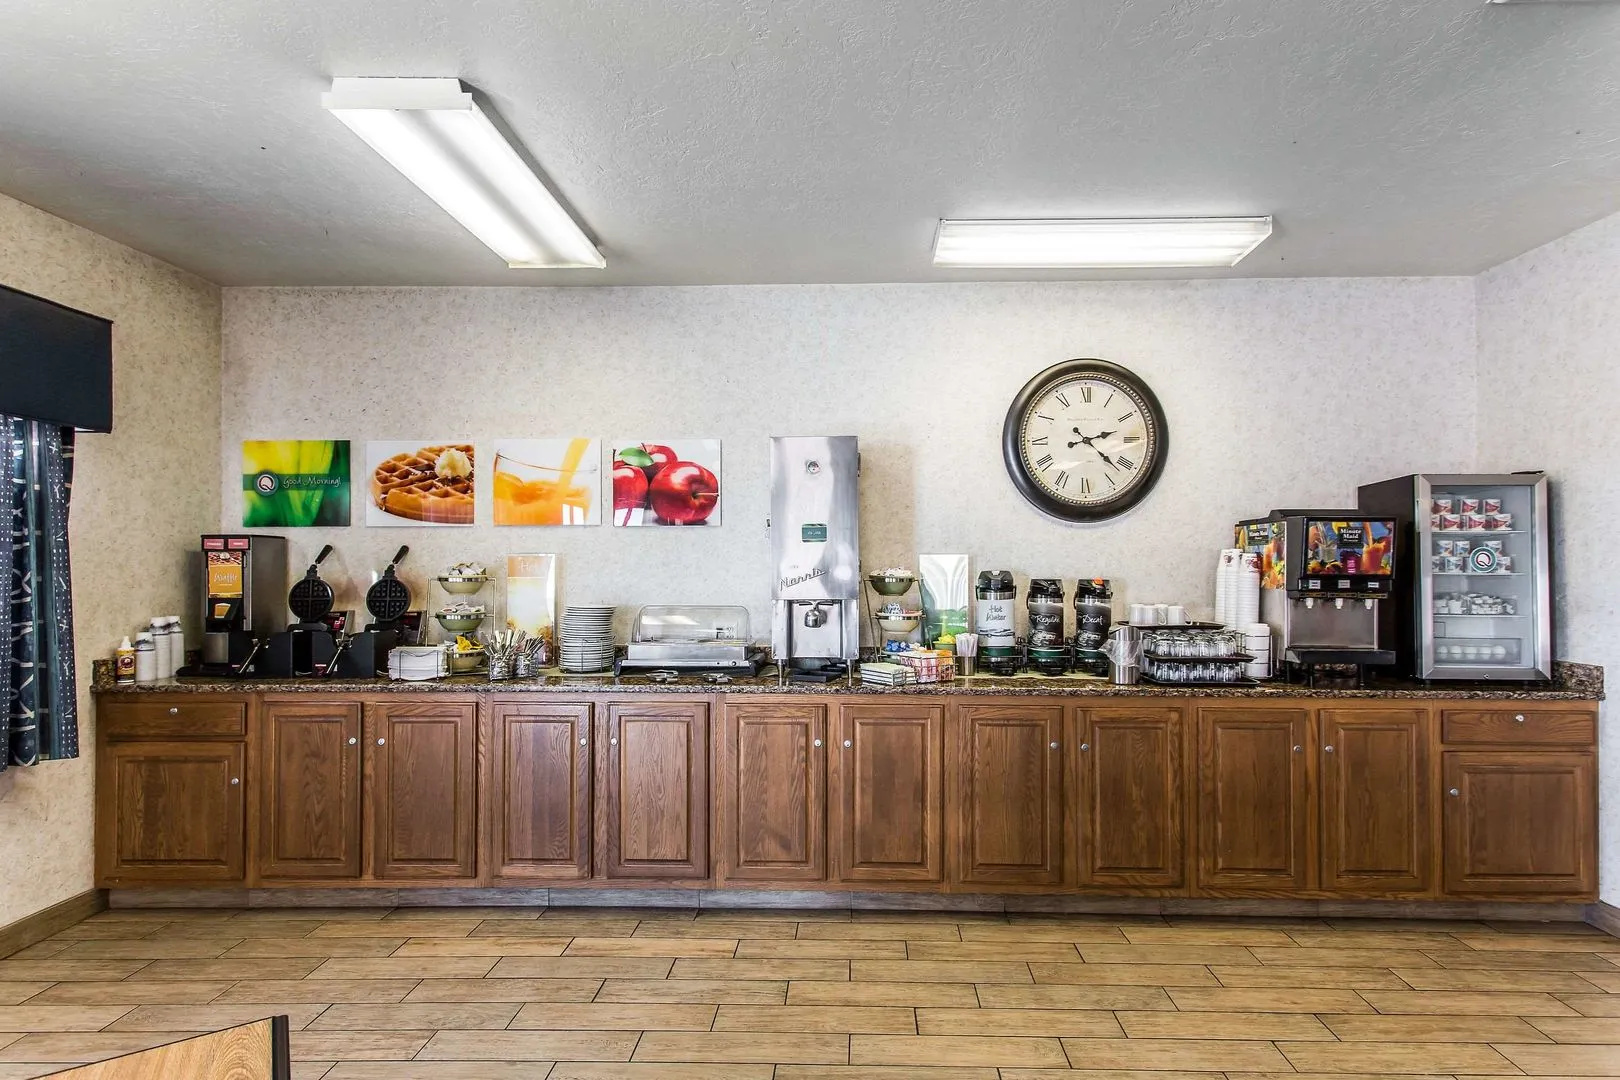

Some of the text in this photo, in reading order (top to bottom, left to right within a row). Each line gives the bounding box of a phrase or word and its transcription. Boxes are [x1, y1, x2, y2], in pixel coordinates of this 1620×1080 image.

[282, 476, 342, 489] Good Morning!
[988, 604, 1003, 613] Hot
[985, 612, 1007, 622] Water
[1082, 614, 1104, 626] Decaf
